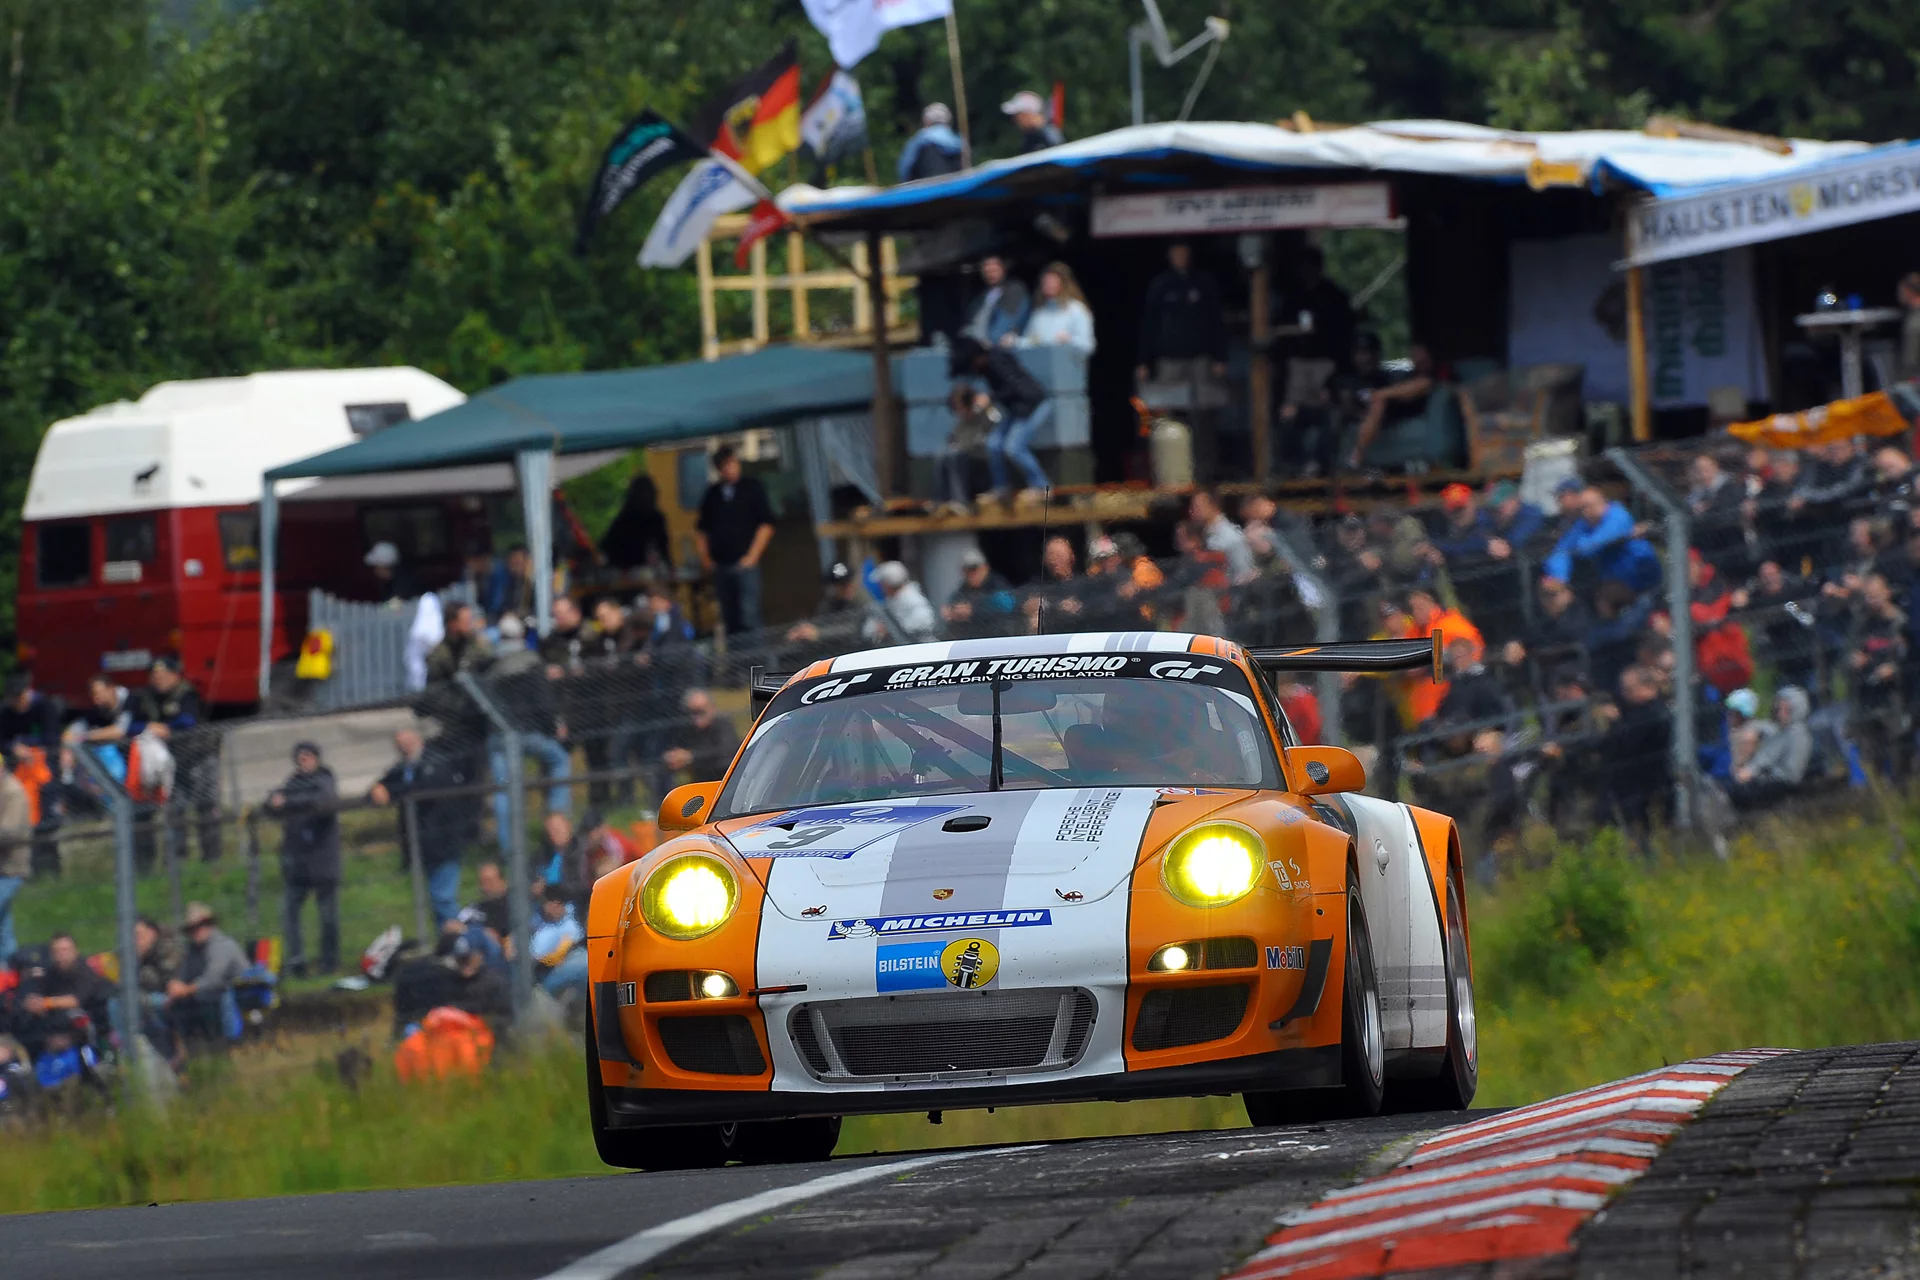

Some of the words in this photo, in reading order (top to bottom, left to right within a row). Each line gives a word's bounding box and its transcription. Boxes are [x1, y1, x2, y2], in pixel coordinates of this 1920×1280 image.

[887, 662, 981, 684] GRAN
[986, 657, 1128, 675] TURISMO
[884, 682, 913, 691] THE
[917, 677, 955, 688] REAL
[1026, 671, 1115, 680] SIMULATOR
[767, 825, 845, 849] 9
[881, 912, 1044, 931] MICHELIN
[879, 956, 938, 972] BILSTEIN
